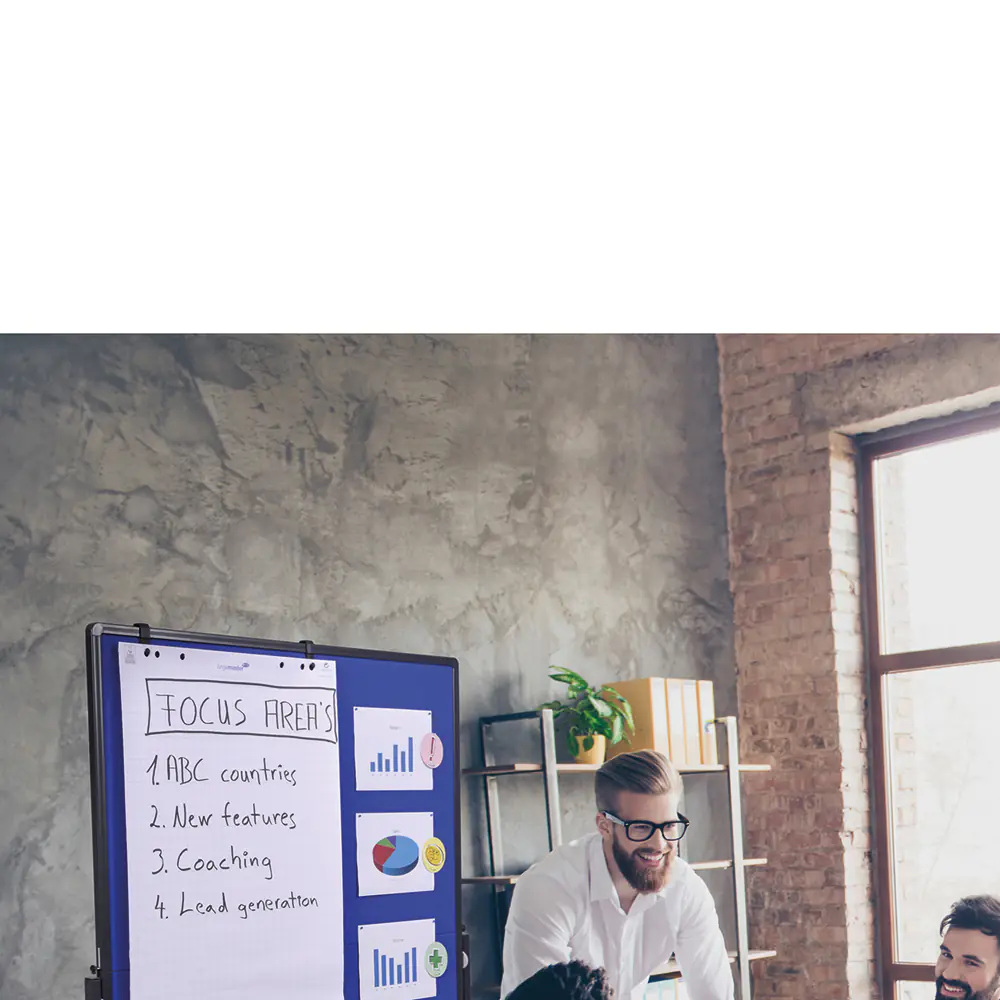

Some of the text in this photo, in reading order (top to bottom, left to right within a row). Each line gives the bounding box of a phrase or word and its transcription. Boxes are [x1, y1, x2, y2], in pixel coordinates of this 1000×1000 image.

[155, 693, 333, 733] FOCUS AREA'S
[146, 754, 297, 787] 1. ABC countries
[149, 801, 297, 830] 2. New features
[151, 845, 274, 881] 3. Coaching
[154, 890, 320, 920] 4. Lead generation
